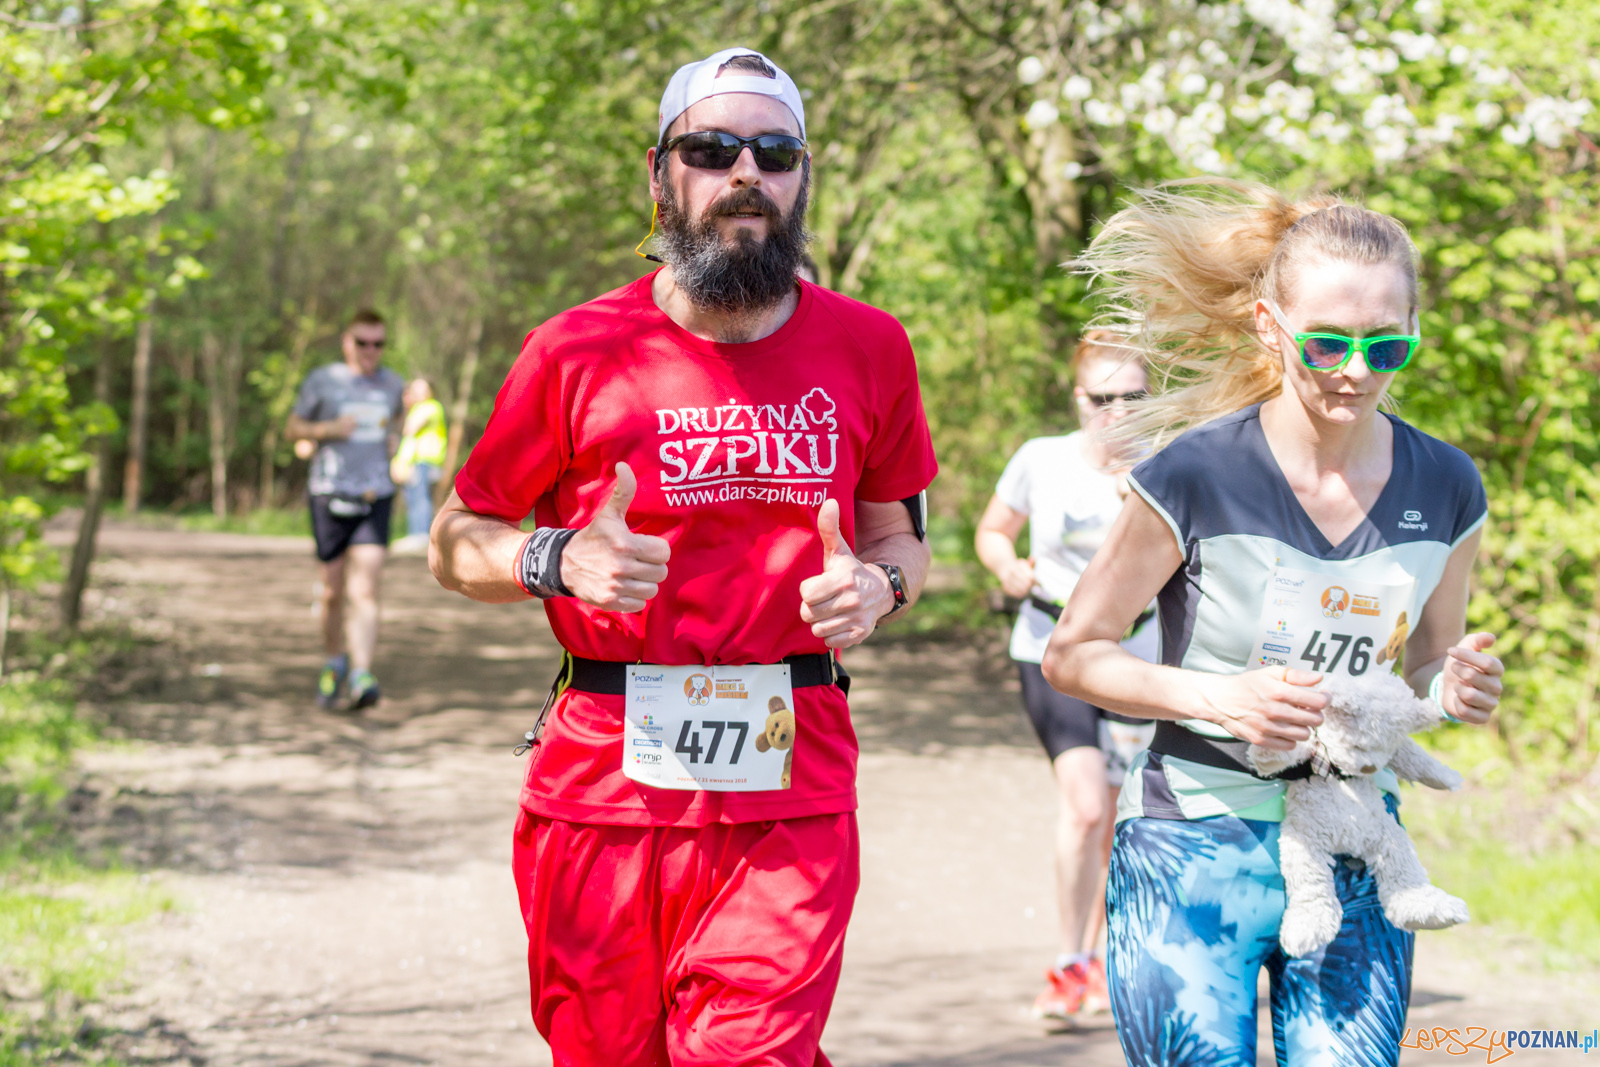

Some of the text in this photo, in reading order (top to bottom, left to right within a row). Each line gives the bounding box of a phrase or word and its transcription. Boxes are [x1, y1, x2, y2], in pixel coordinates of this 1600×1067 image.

[656, 398, 810, 434] DRUŻYNA
[659, 431, 839, 484] SZPIKU
[665, 483, 827, 507] www.darszpiku.pl
[1300, 630, 1374, 677] 476
[643, 753, 662, 762] mjp
[675, 720, 749, 765] 477
